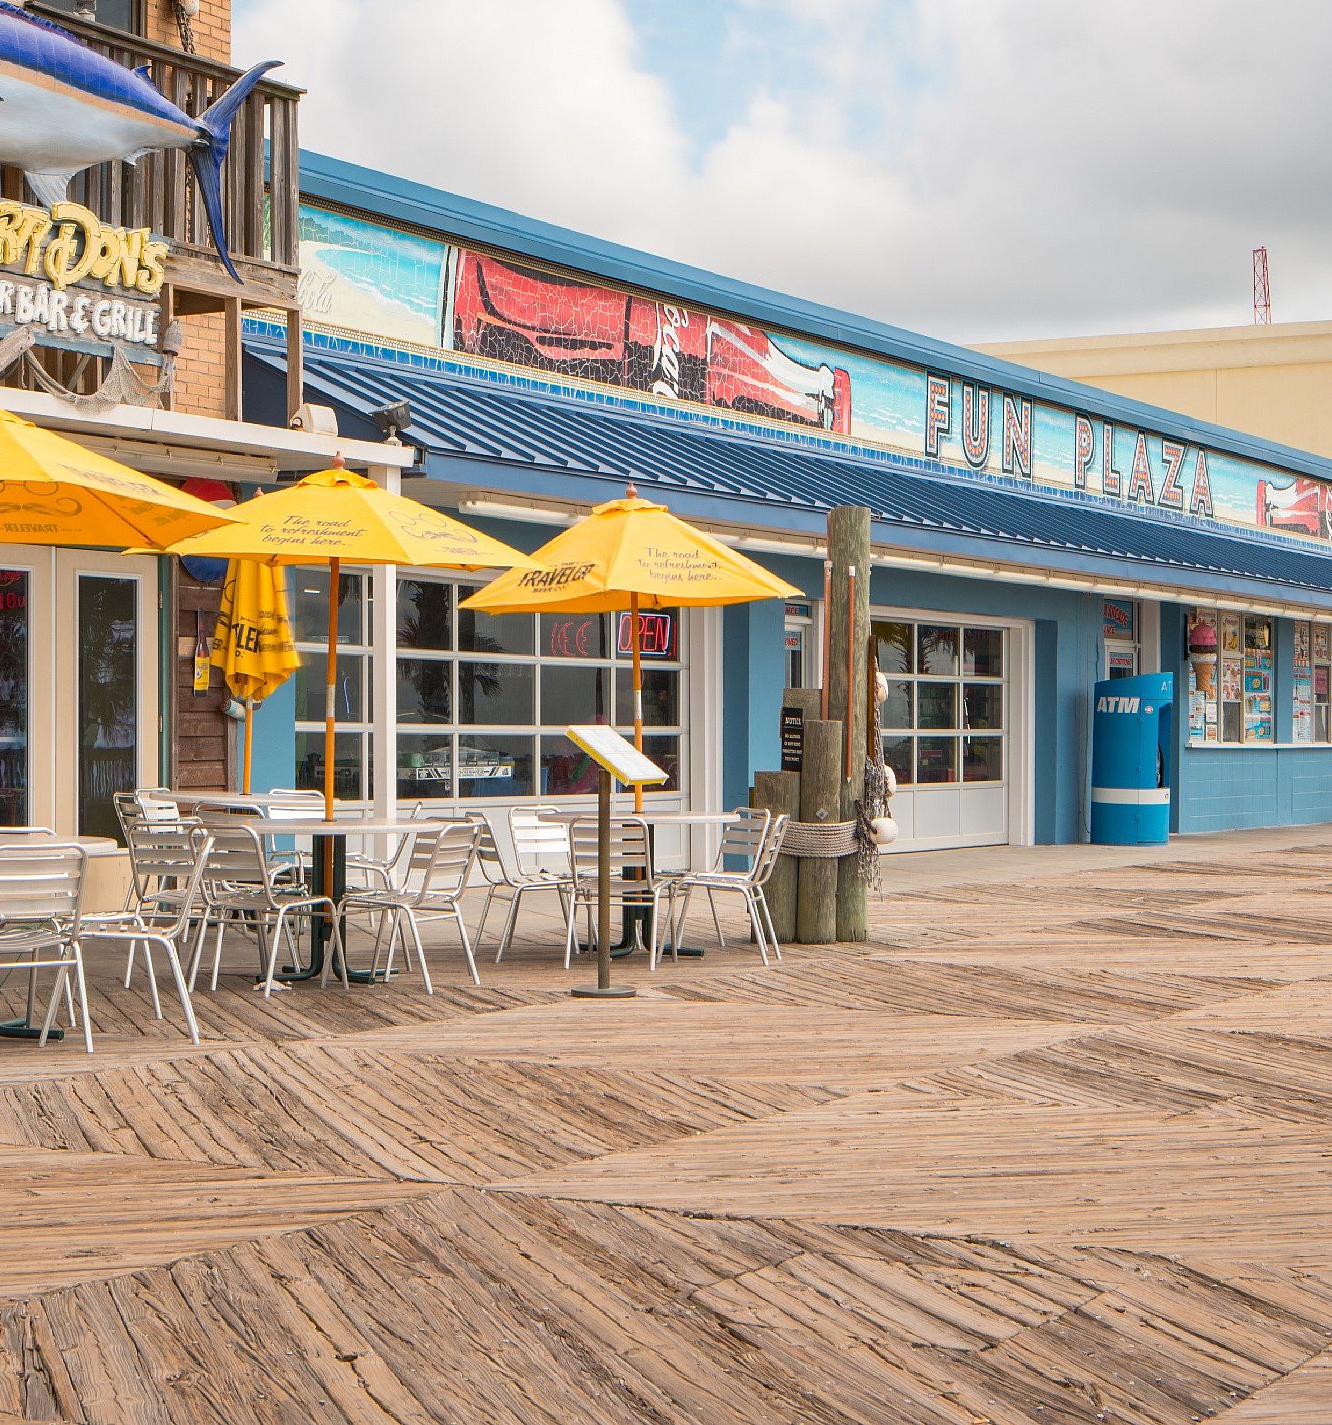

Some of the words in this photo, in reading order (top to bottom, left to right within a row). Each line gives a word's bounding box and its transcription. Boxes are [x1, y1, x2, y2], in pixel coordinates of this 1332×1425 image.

[15, 282, 69, 332] BAR
[69, 293, 92, 335] &
[91, 300, 159, 346] GRILL
[924, 371, 1034, 479] FUN
[1074, 411, 1215, 518] PLAZA
[283, 515, 310, 525] The
[316, 519, 352, 527] road
[260, 523, 275, 533] to
[262, 533, 306, 546] begins
[644, 547, 668, 558] The
[672, 549, 700, 559] road
[635, 558, 650, 568] to
[649, 569, 684, 584] begins
[1097, 696, 1140, 713] ATM
